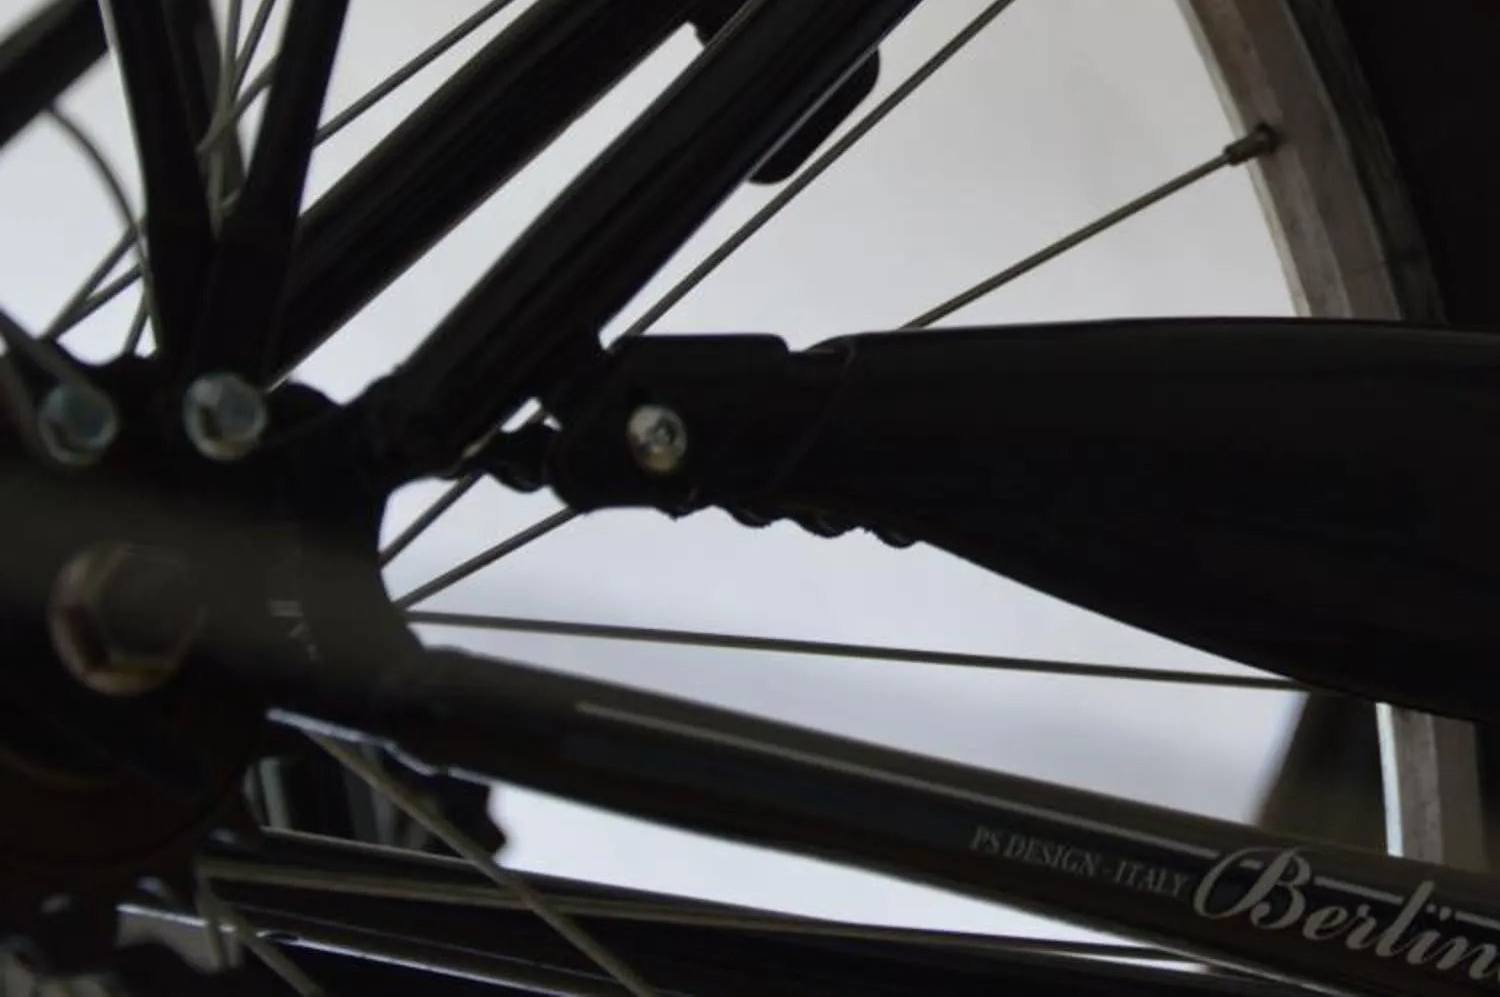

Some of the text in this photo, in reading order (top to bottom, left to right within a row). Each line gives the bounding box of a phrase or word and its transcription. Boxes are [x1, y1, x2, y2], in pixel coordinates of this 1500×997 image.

[969, 824, 1001, 853] PS
[1002, 833, 1101, 878] DESIGN
[1112, 859, 1188, 898] ITALY
